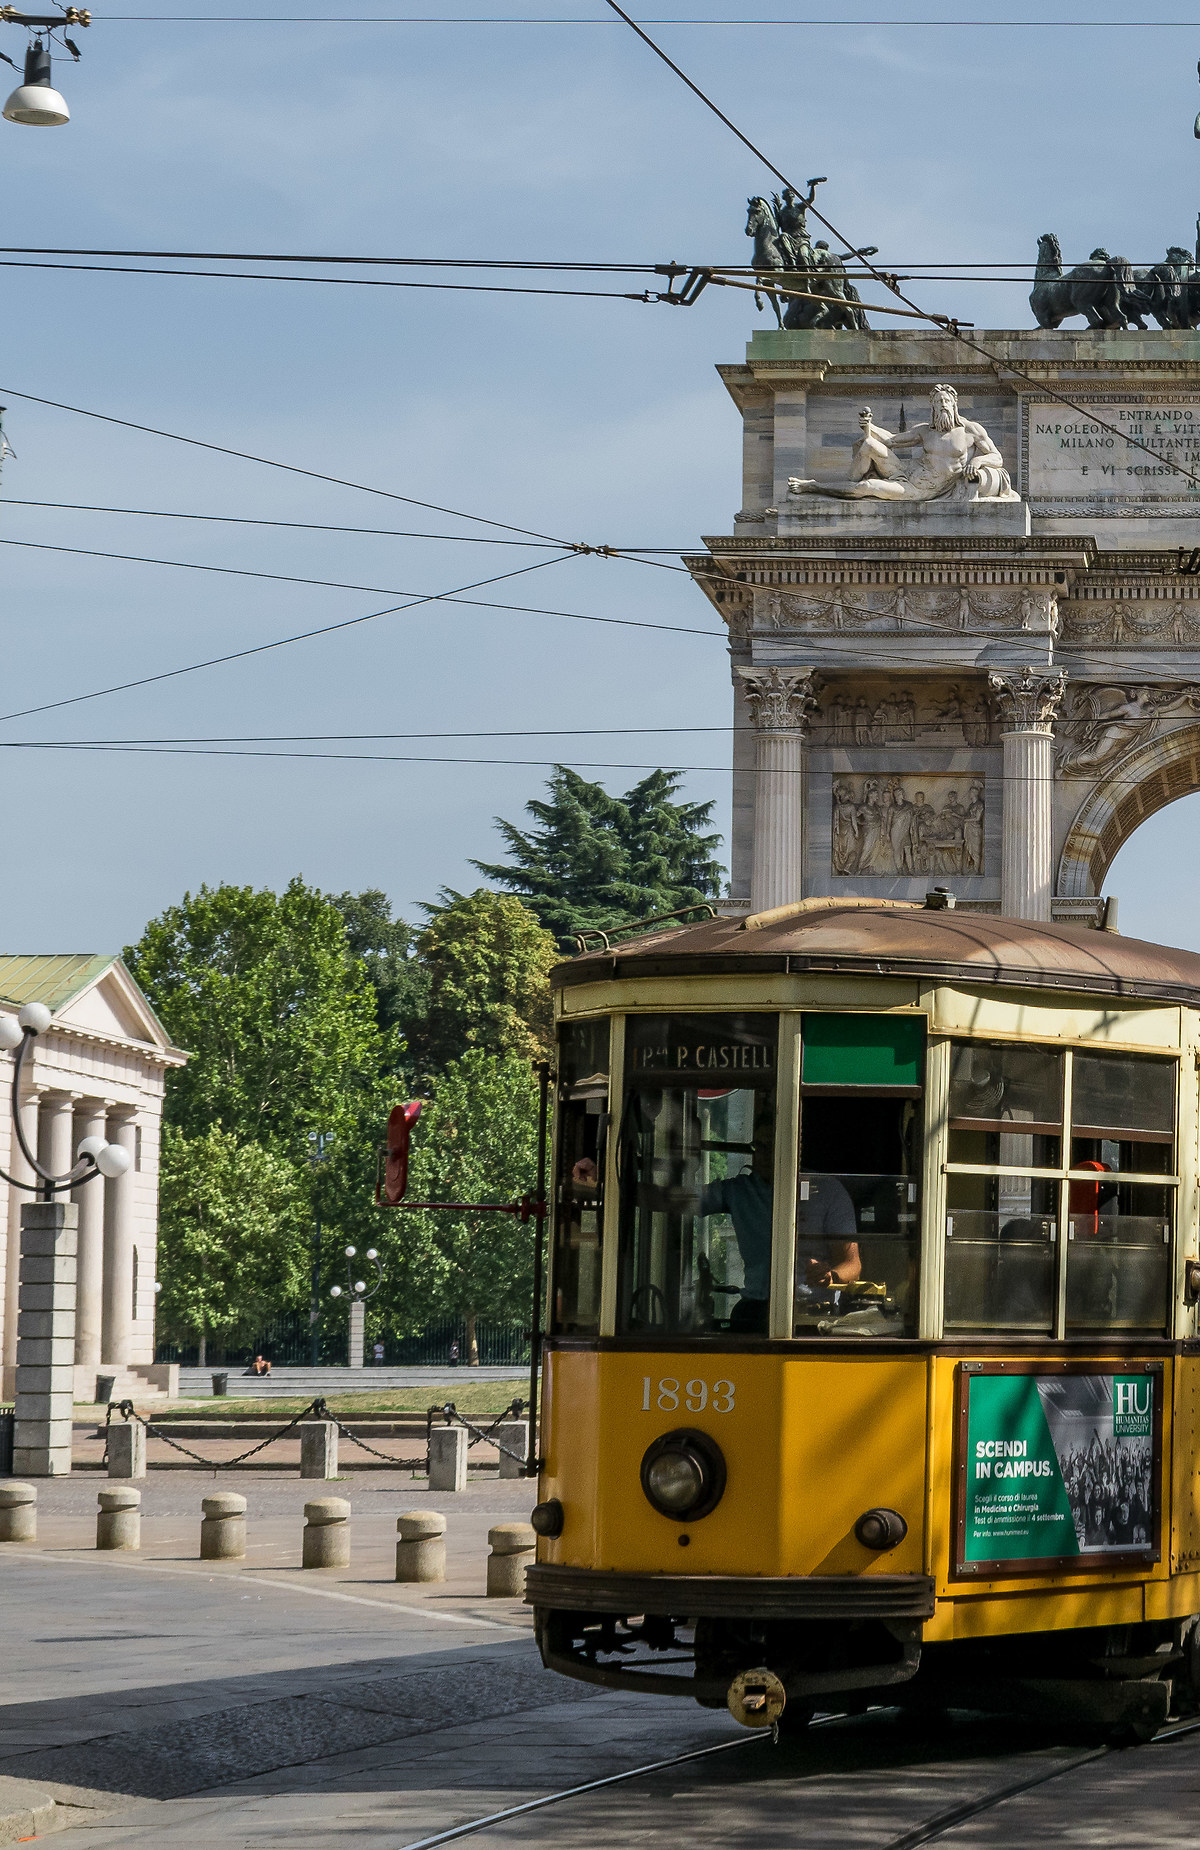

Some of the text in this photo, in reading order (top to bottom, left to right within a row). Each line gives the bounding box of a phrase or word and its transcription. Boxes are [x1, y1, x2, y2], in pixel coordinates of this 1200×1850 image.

[1120, 410, 1193, 421] ENTRANDO
[1036, 424, 1117, 434] NAPOLEONE
[1130, 424, 1143, 434] III
[1155, 424, 1162, 434] E
[1060, 438, 1115, 448] MILANO
[1126, 438, 1200, 448] ESULTANTE
[1082, 466, 1088, 476] E
[1101, 466, 1115, 476] VI
[1127, 466, 1179, 476] SCRISSE
[641, 1377, 736, 1413] 1893
[1115, 1383, 1149, 1414] HU
[1115, 1415, 1149, 1424] HUMANITAS
[1115, 1424, 1149, 1433] UNIVERSITY
[976, 1440, 1027, 1458] SCENDI
[976, 1460, 1053, 1479] IN CAMPUS.
[975, 1494, 992, 1504] Scegli
[998, 1494, 1013, 1502] corso
[1014, 1493, 1020, 1501] di
[1021, 1493, 1038, 1501] laurea
[974, 1505, 980, 1513] in
[981, 1504, 1007, 1513] Medicina
[1013, 1503, 1039, 1512] Chirurgia
[974, 1516, 986, 1524] Test
[987, 1515, 993, 1524] di
[994, 1515, 1026, 1523] ammissione
[973, 1530, 981, 1538] Per
